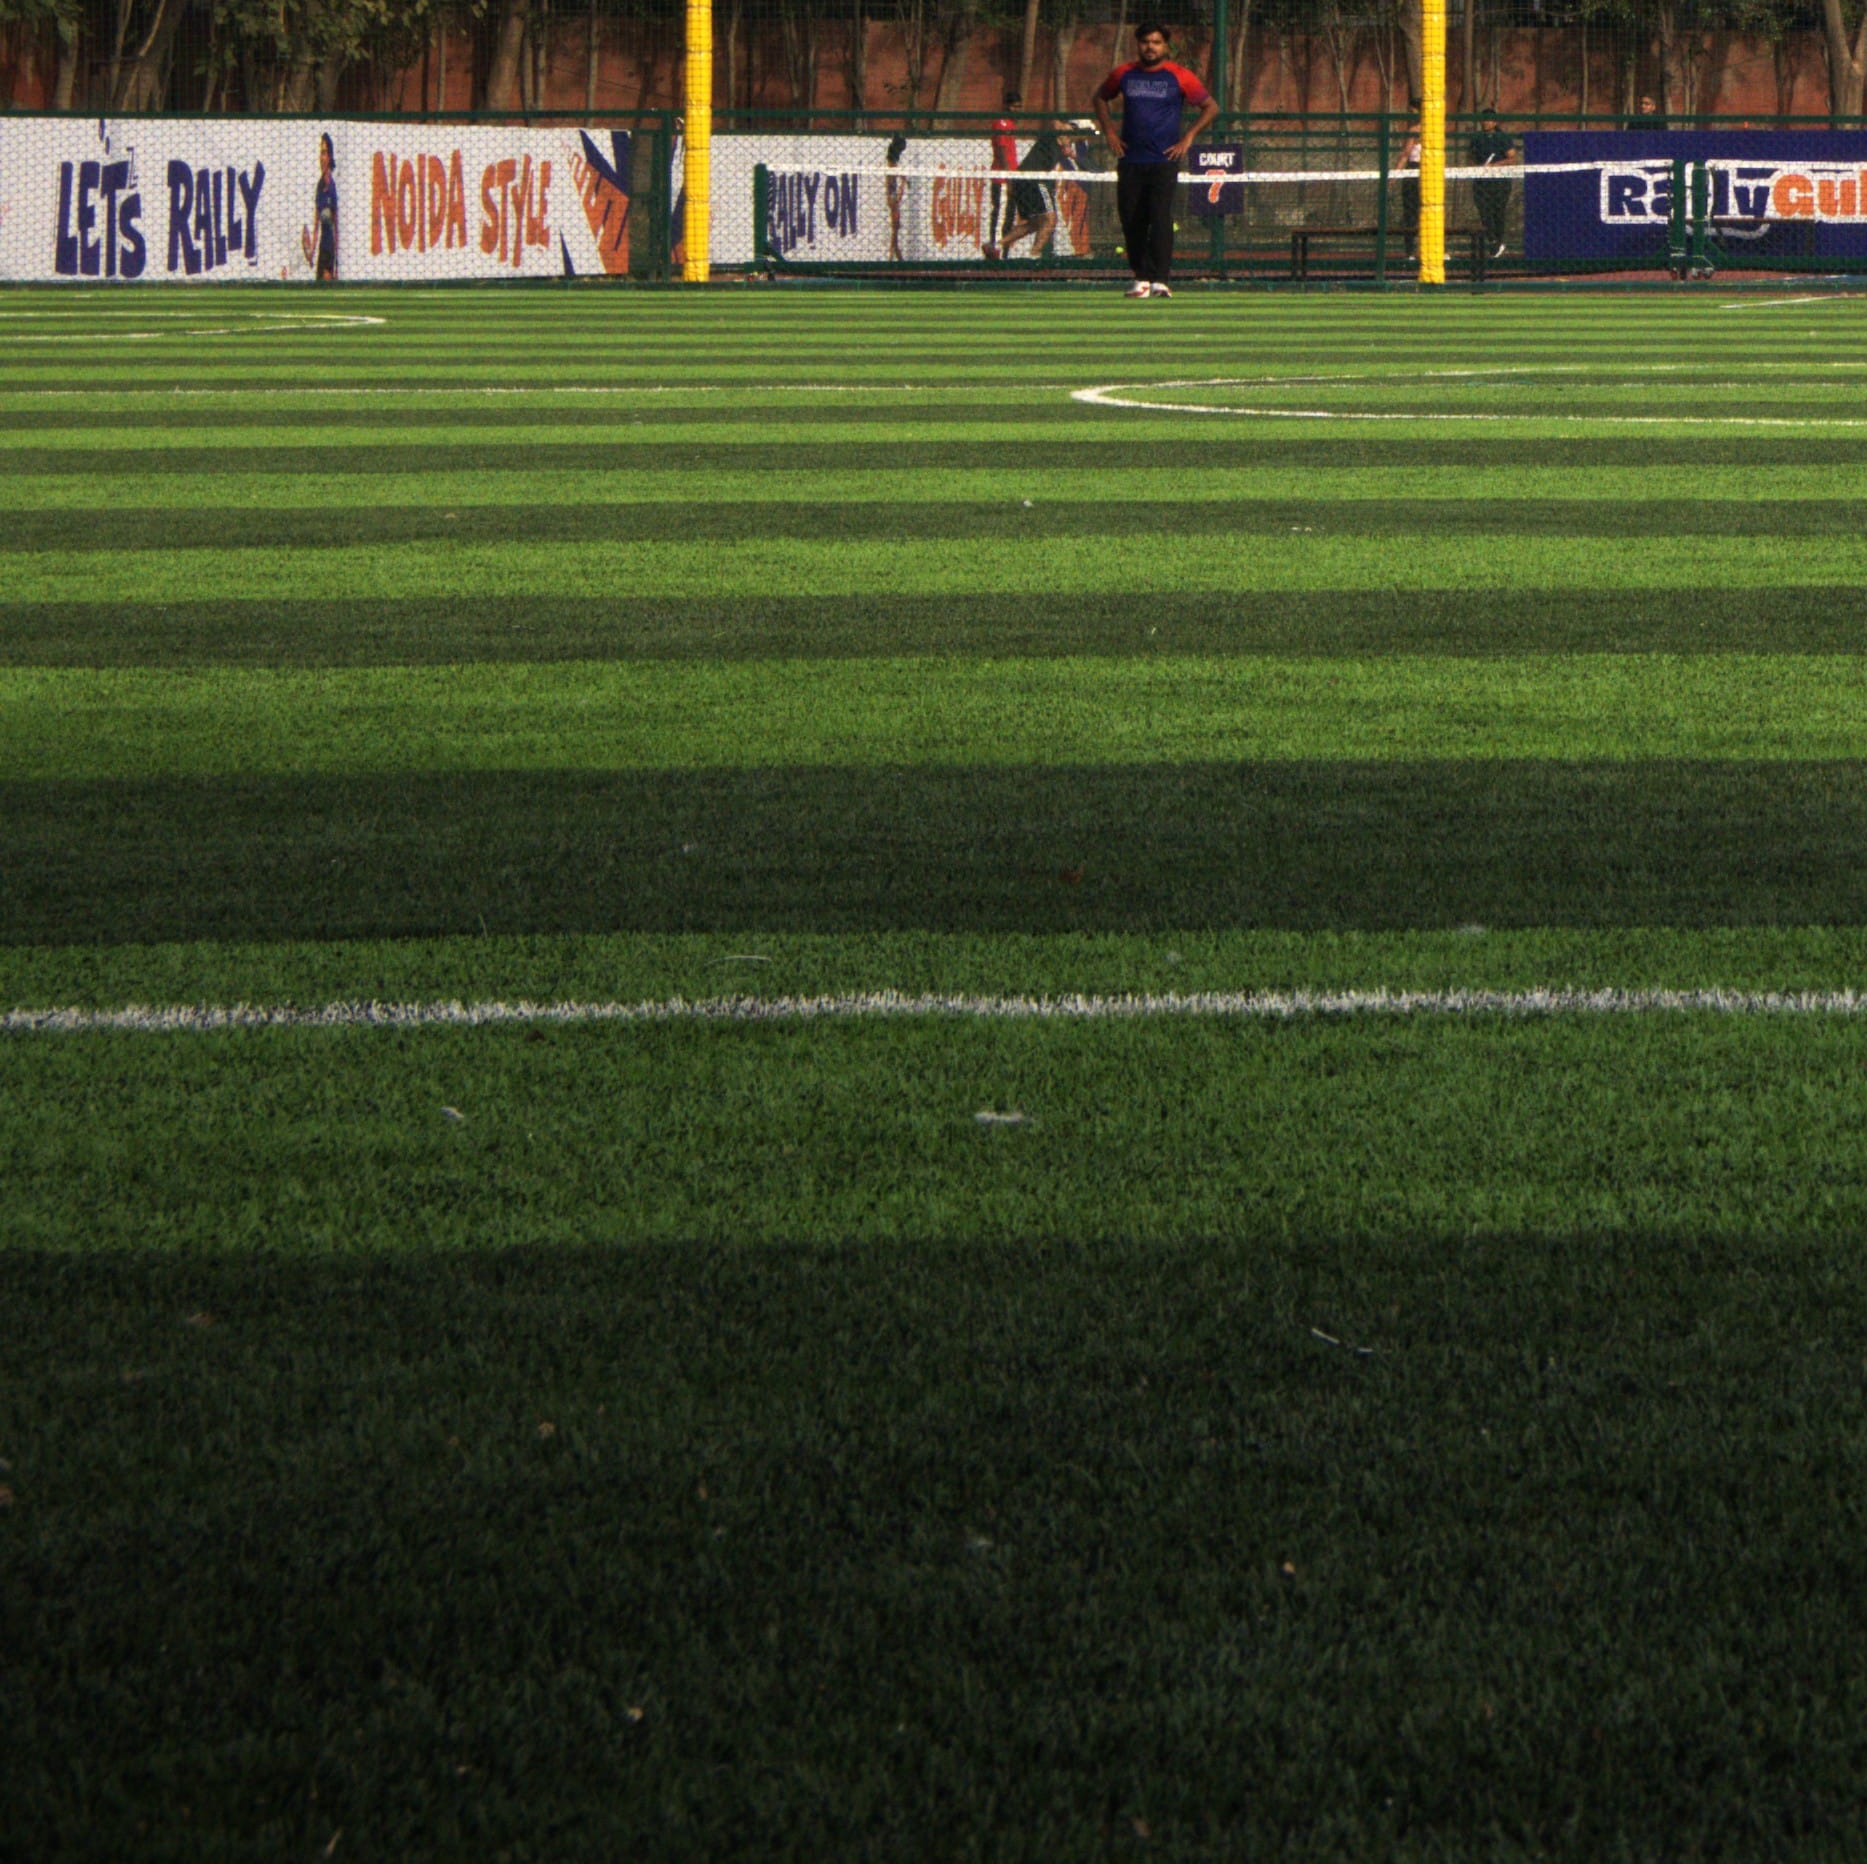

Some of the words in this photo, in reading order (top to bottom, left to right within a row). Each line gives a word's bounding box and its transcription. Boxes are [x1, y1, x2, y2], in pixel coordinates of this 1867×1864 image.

[1199, 152, 1236, 167] COURT
[1204, 169, 1228, 204] 7
[167, 159, 266, 276] RALLY
[371, 149, 467, 256] NOIDA
[480, 153, 552, 268] STYLE
[824, 172, 859, 238] ON
